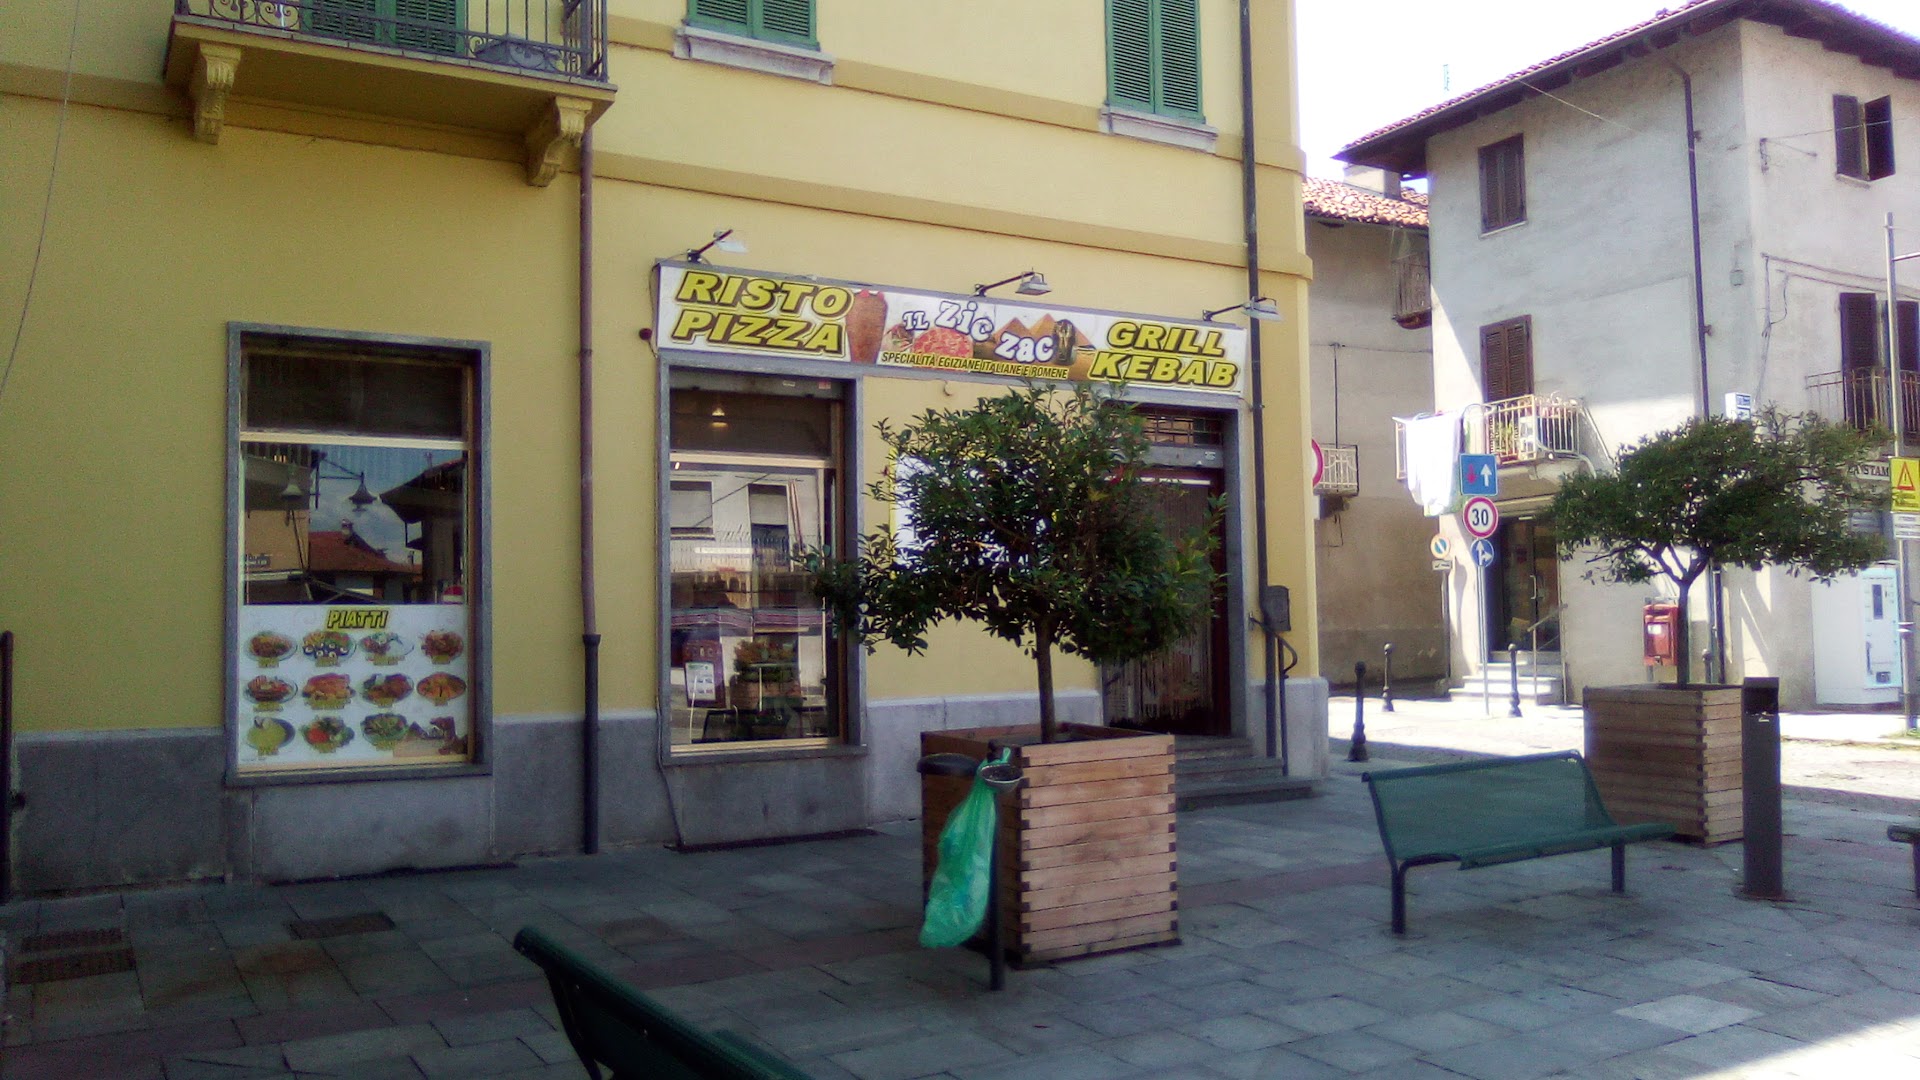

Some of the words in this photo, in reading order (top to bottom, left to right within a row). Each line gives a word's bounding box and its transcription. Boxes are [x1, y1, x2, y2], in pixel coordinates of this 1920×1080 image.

[675, 270, 853, 318] RISTO
[671, 309, 843, 355] PIZZA
[1106, 322, 1225, 358] GRILL
[881, 351, 935, 367] SPECIALITÀ
[937, 357, 981, 371] EGIZIANE
[981, 361, 1022, 375] ITALIANE
[1022, 365, 1030, 375] E
[1030, 366, 1069, 380] ROMENE
[1089, 350, 1239, 389] KEBAB
[1472, 508, 1489, 526] 30
[326, 609, 389, 629] PIATTI
